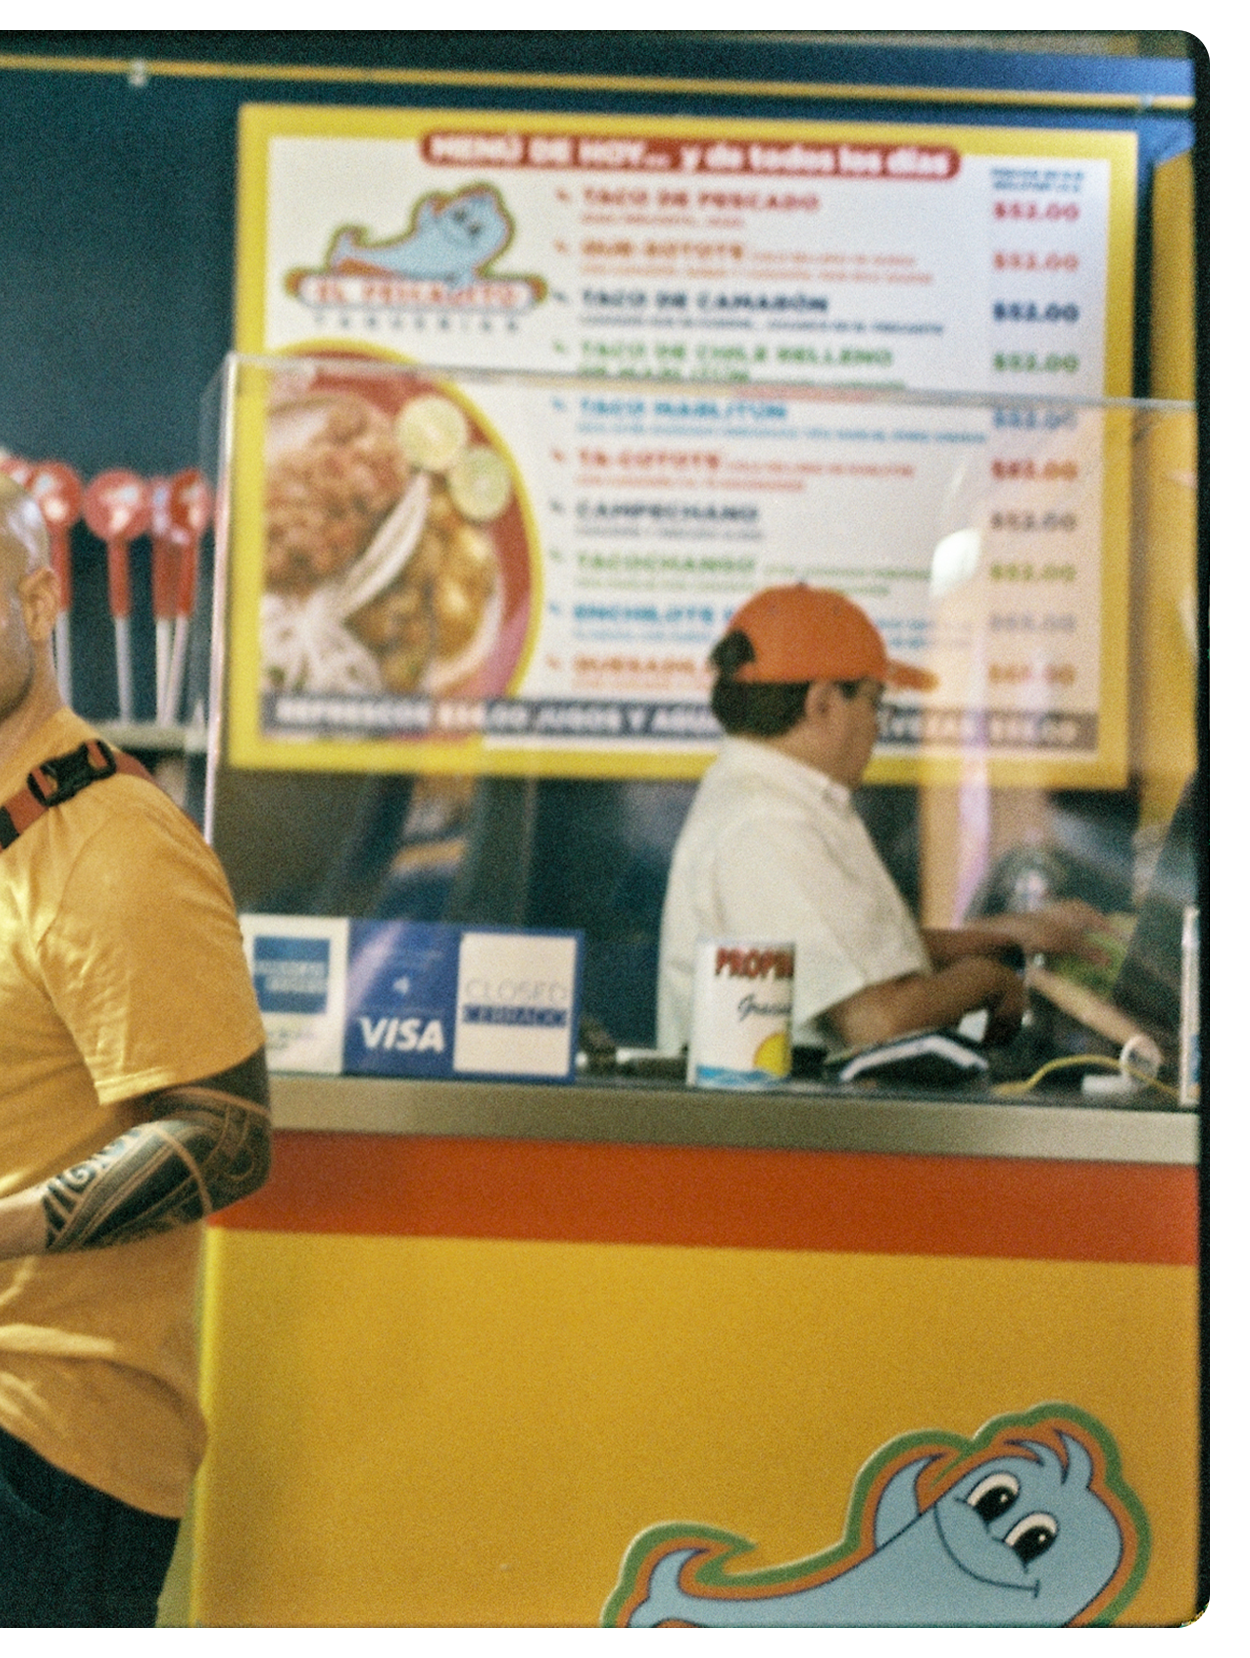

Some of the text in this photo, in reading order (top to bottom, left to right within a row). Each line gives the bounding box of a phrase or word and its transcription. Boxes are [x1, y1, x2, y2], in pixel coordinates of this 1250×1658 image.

[529, 137, 571, 163] DE
[704, 141, 744, 168] de
[750, 143, 834, 170] todos
[657, 189, 689, 207] DE
[655, 291, 687, 308] DE
[464, 976, 570, 1003] CLOSED
[358, 1016, 446, 1054] VISA
